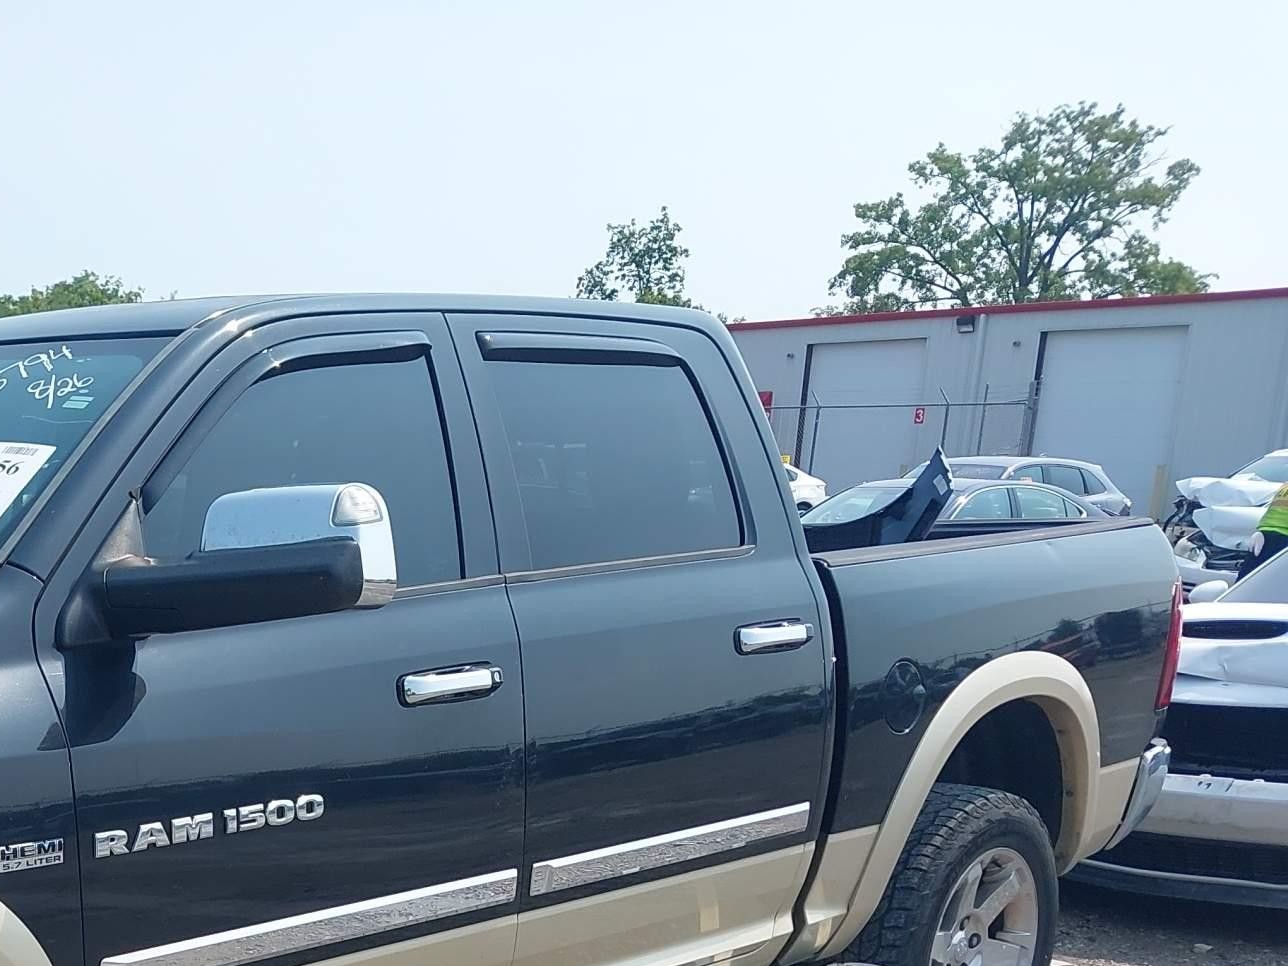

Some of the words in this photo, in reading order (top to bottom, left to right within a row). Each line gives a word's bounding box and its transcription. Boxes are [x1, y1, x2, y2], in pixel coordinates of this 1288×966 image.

[26, 373, 94, 408] 8/26
[915, 409, 924, 423] 3
[94, 812, 214, 858] RAM
[223, 793, 325, 834] 1500
[0, 839, 64, 861] HEMI
[2, 861, 22, 871] 5.7
[26, 855, 62, 867] LITER
